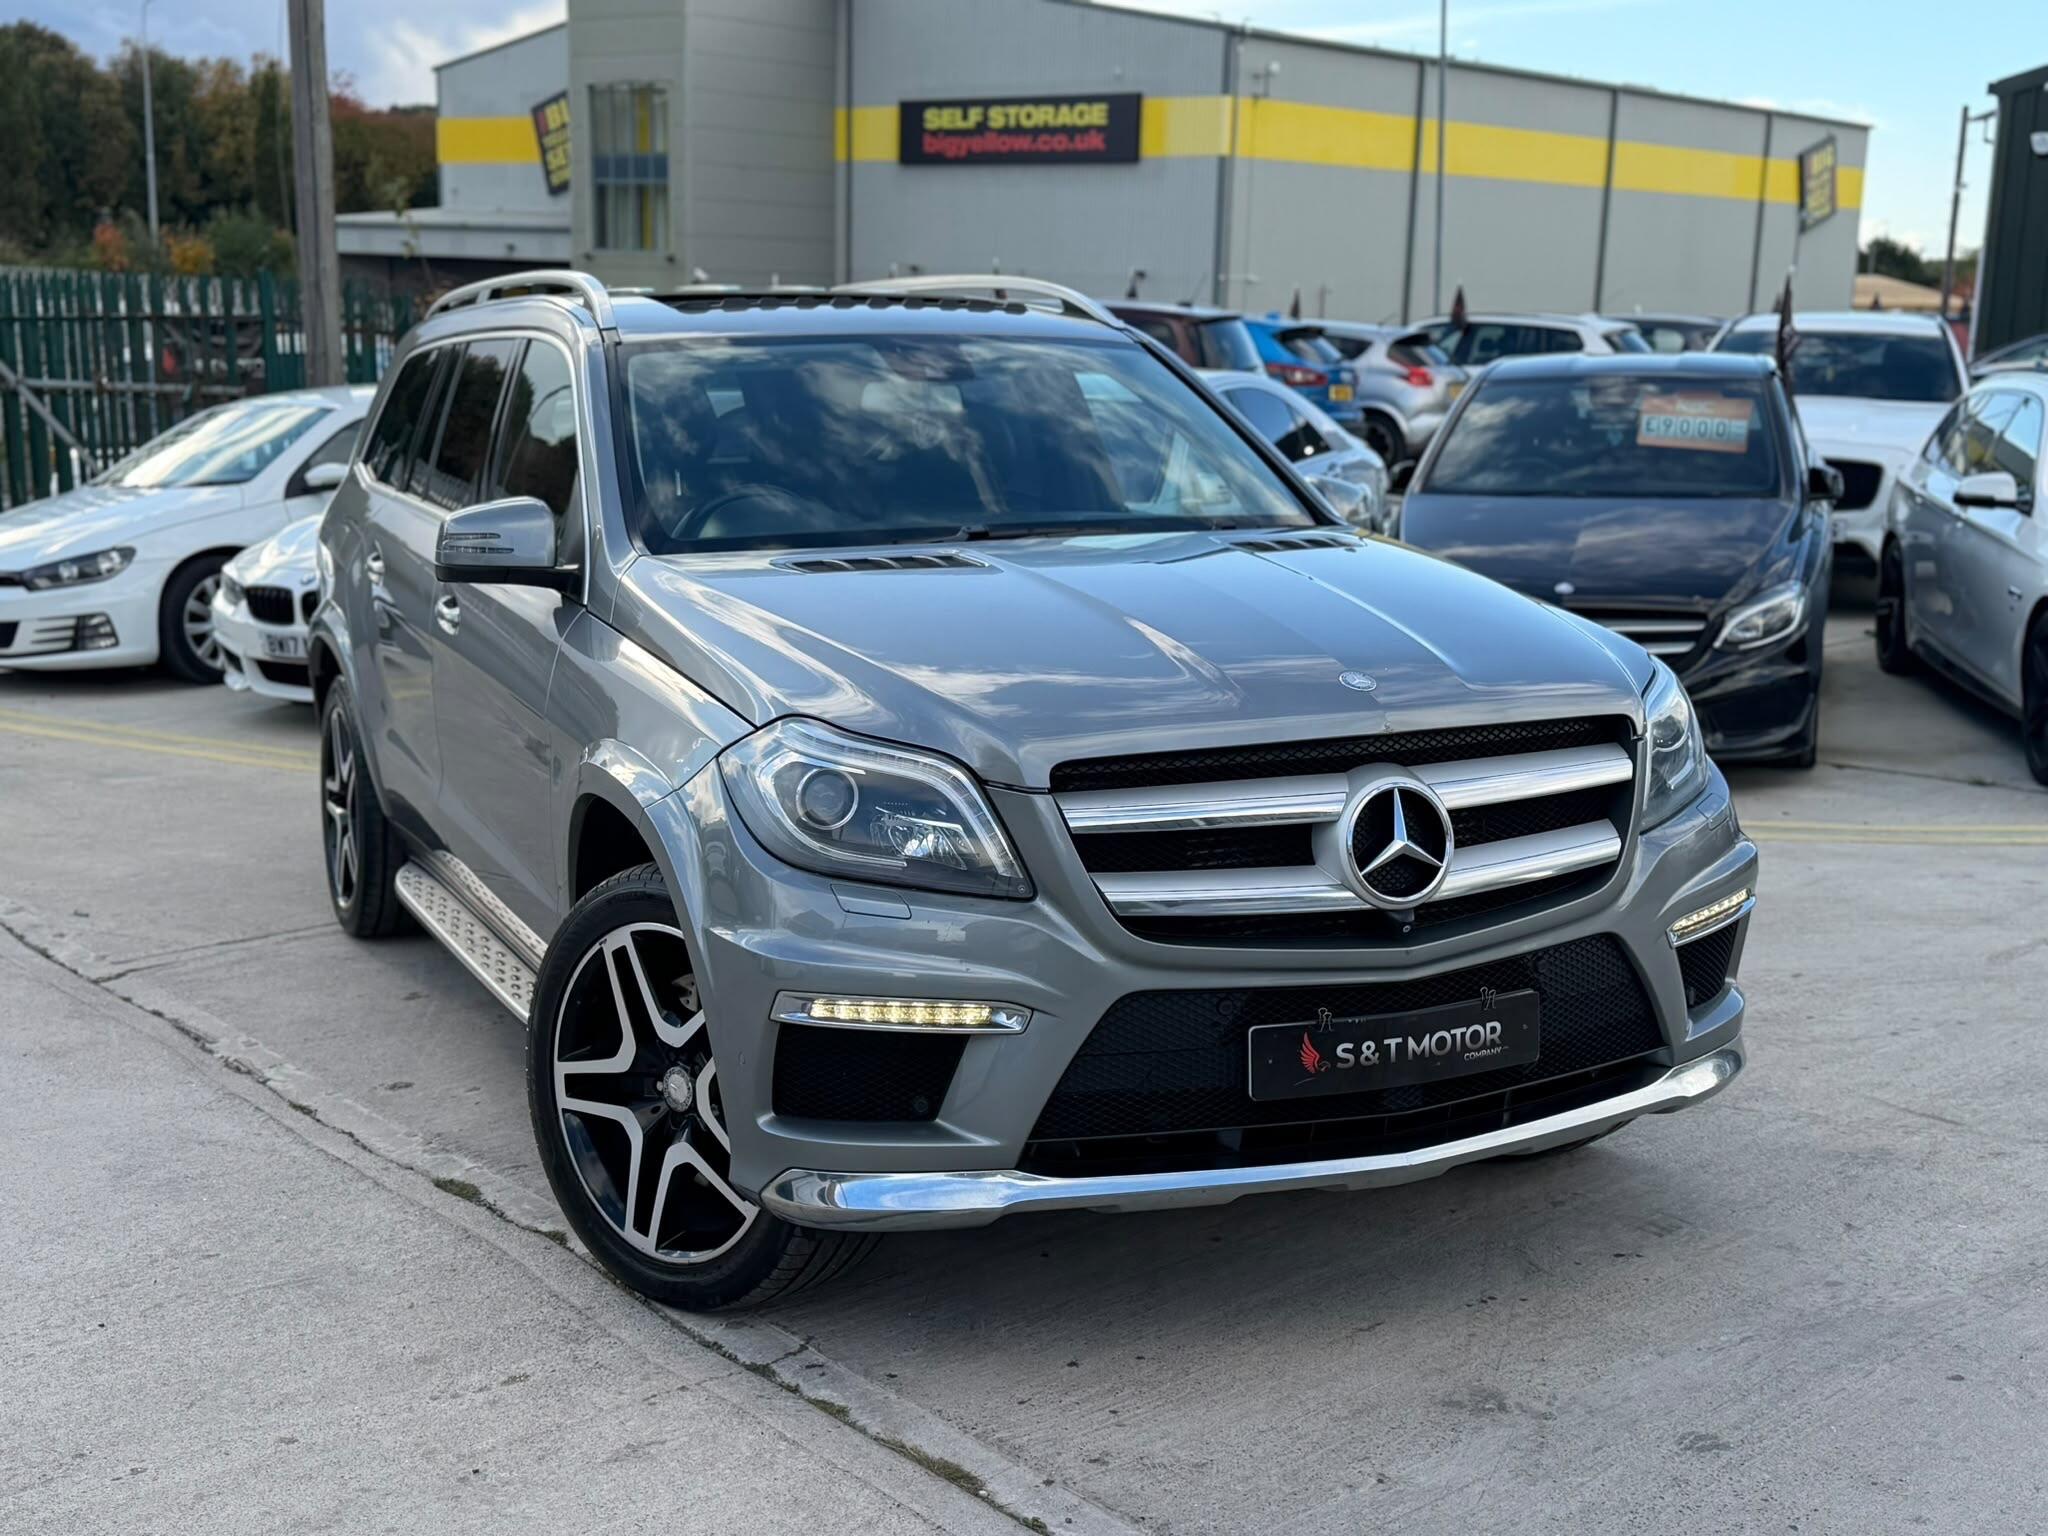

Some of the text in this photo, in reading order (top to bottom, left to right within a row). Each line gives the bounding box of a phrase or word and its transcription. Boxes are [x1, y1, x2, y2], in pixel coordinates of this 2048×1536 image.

[923, 102, 1109, 131] SELF STORAGE
[922, 130, 1106, 158] bigyellow.co.uk
[1335, 1020, 1502, 1069] S & T MOTOR
[1463, 1046, 1503, 1062] COMPANY
